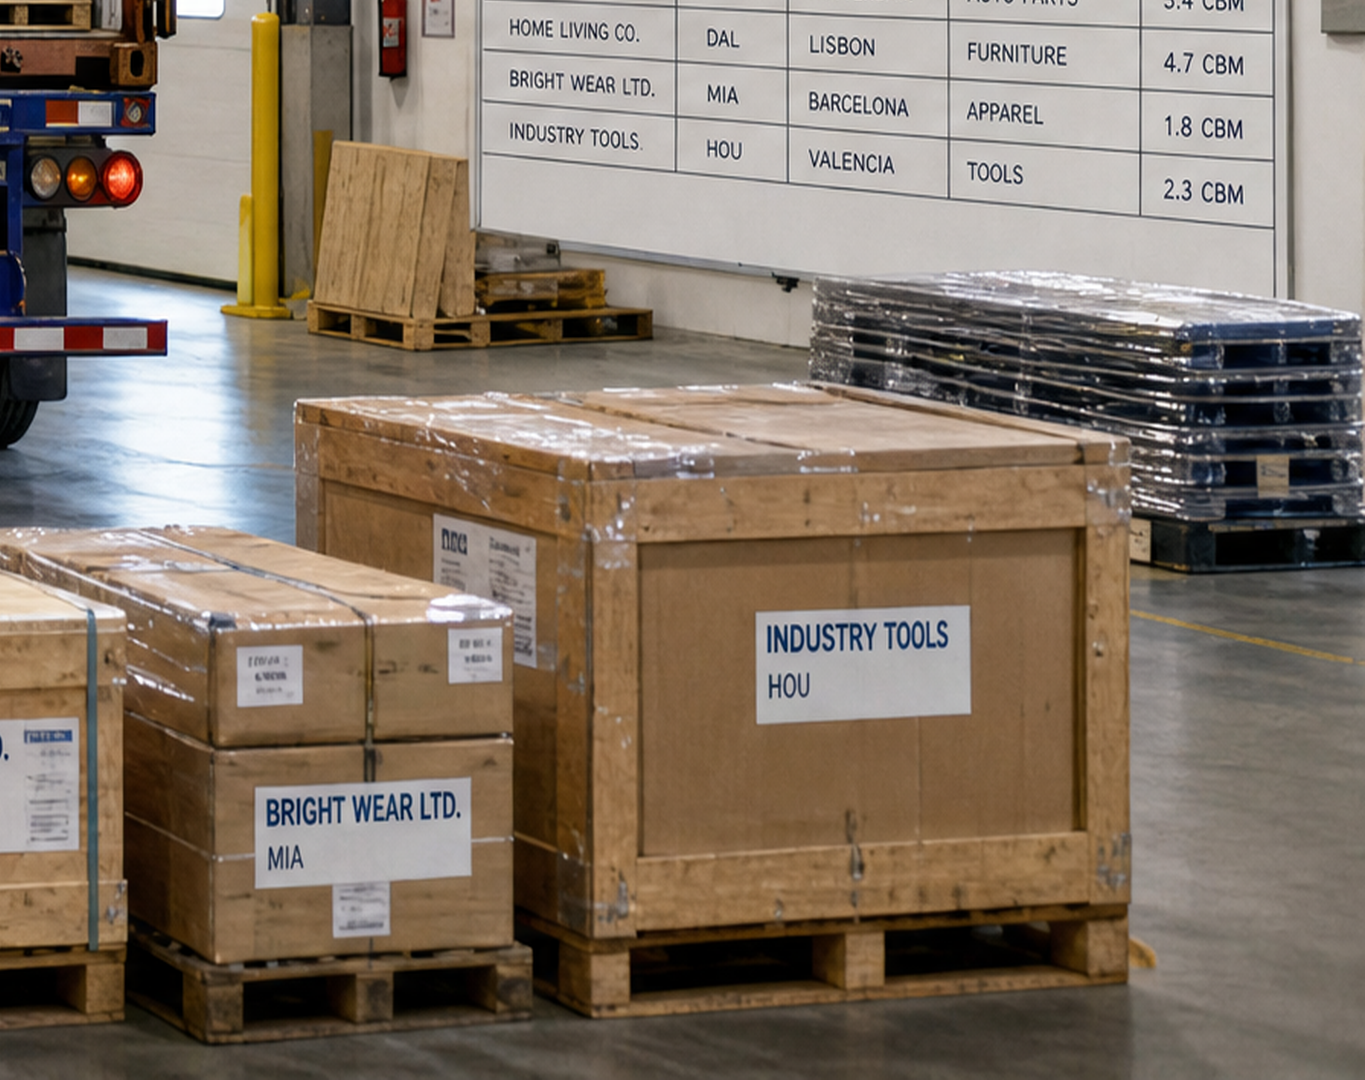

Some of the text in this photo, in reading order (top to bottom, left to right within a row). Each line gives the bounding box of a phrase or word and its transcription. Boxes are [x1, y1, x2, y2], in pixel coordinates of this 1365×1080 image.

[509, 18, 640, 43] HOME LIVING CO.
[706, 28, 740, 49] DAL
[809, 34, 875, 57] LISBON
[967, 41, 1067, 67] FURNITURE
[1163, 51, 1244, 76] 4.7 CBM
[509, 69, 656, 98] BRIGHT WEAR LTD.
[707, 84, 739, 105] MIA
[808, 91, 909, 118] BARCELONA
[966, 101, 1044, 125] APPAREL
[509, 122, 585, 145] INDUSTRY
[1165, 115, 1243, 140] 1.8 CBM
[706, 139, 743, 161] HOU
[808, 148, 895, 175] VALENCIA
[966, 161, 1024, 185] TOOLS
[1163, 178, 1244, 205] 2.3 CBM
[766, 619, 949, 654] INDUSTRY TOOLS
[768, 672, 810, 700] HOU
[266, 790, 461, 828] BRIGHT WEAR LTD.
[267, 844, 304, 871] MIA
